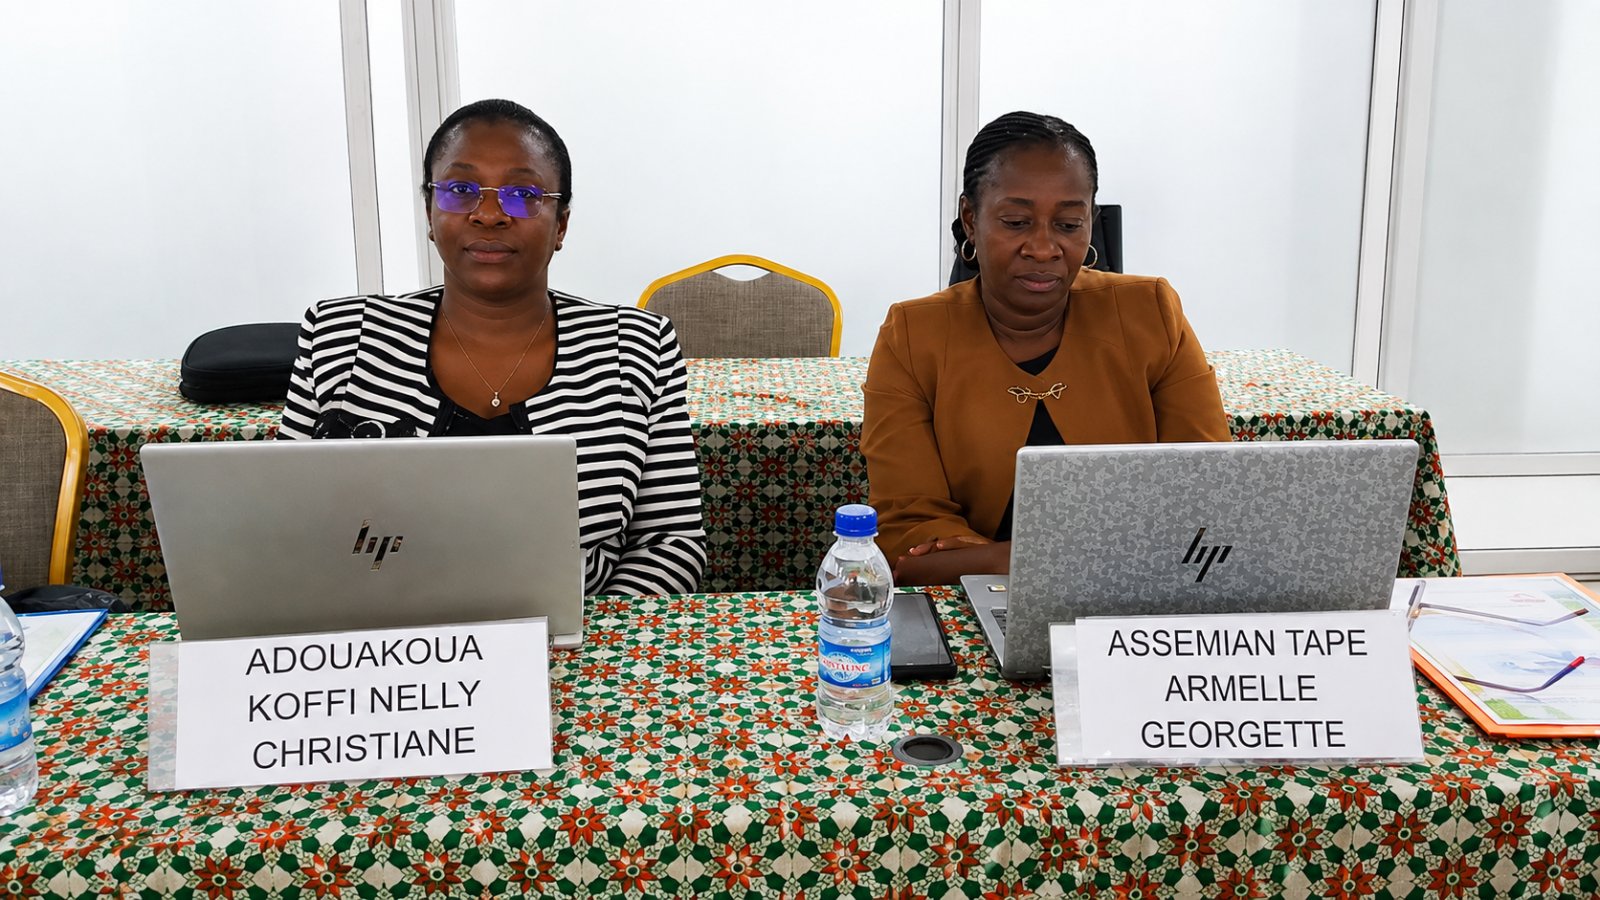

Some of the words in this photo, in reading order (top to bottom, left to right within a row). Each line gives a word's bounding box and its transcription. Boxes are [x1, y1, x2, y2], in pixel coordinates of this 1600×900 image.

[352, 519, 404, 571] hp
[1181, 527, 1233, 583] hp
[246, 635, 484, 676] ADOUAKOUA
[1108, 629, 1275, 657] ASSEMIAN
[1284, 629, 1368, 656] TAPE
[249, 688, 355, 723] KOFFI
[371, 680, 481, 714] NELLY
[1164, 674, 1318, 702] ARMELLE
[253, 727, 476, 770] CHRISTIANE
[1141, 720, 1346, 749] GEORGETTE
